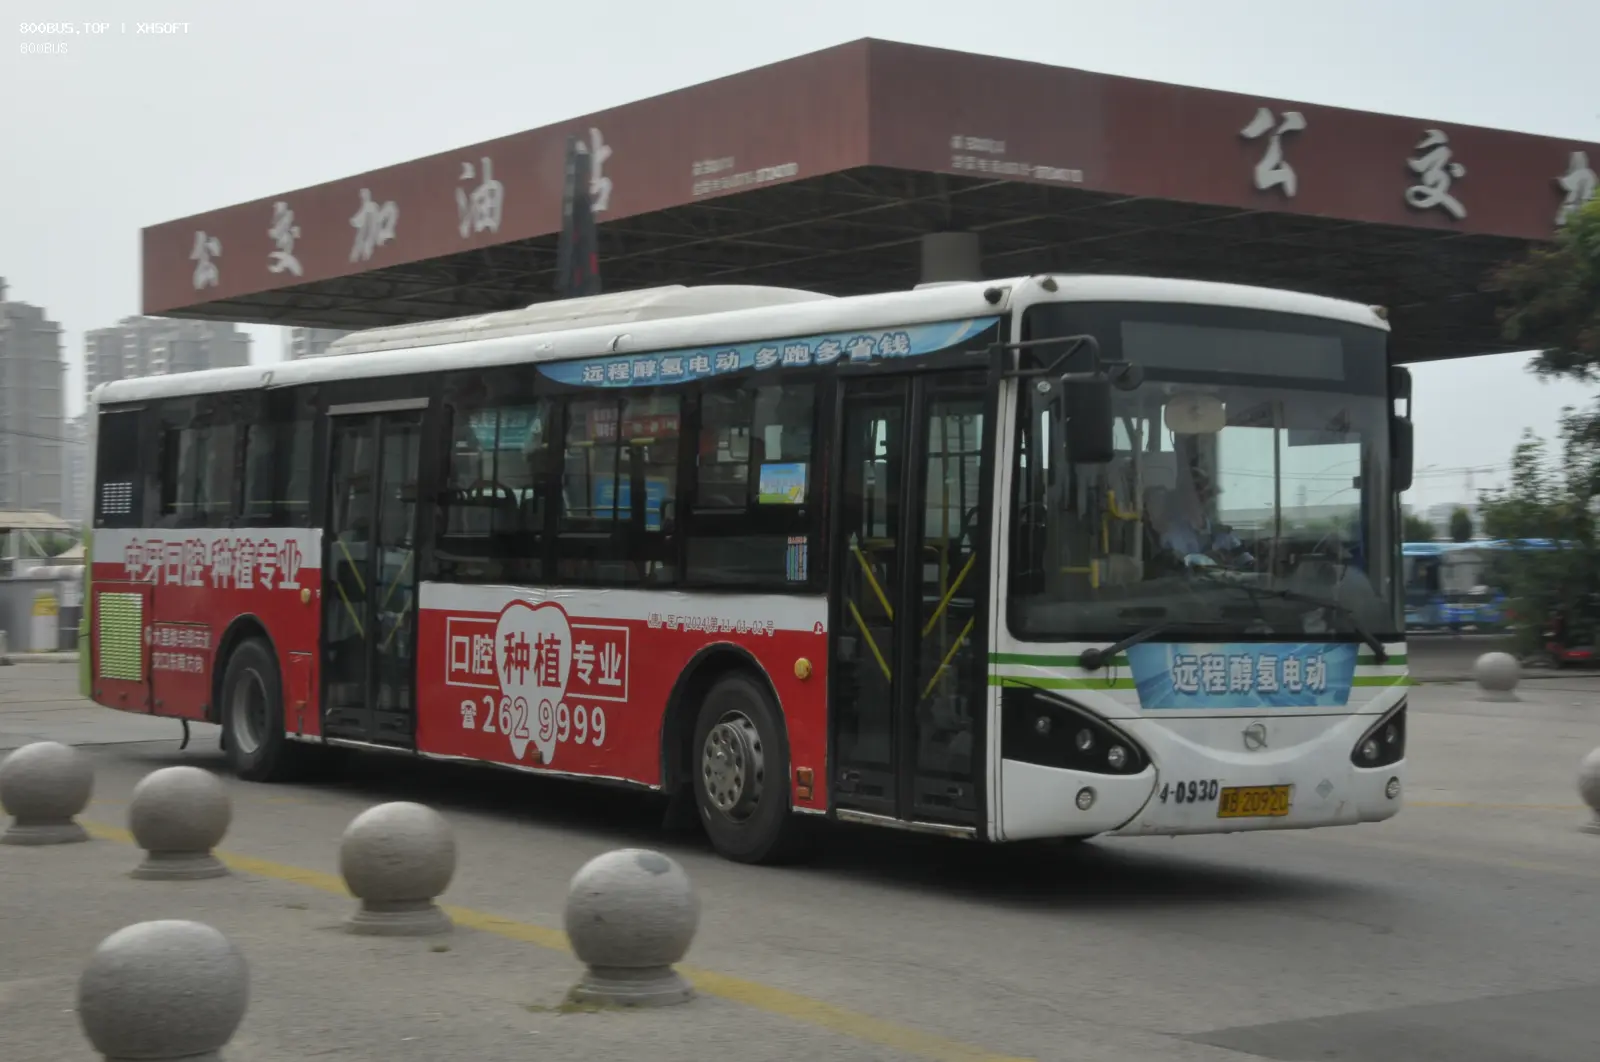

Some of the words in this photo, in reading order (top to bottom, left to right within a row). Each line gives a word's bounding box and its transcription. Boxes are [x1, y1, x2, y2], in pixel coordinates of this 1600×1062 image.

[582, 350, 740, 383] 远程醇氢电动
[754, 331, 911, 371] 多跑多省钱
[211, 538, 302, 590] 种植专业
[1173, 654, 1327, 695] 远程醇氢电动
